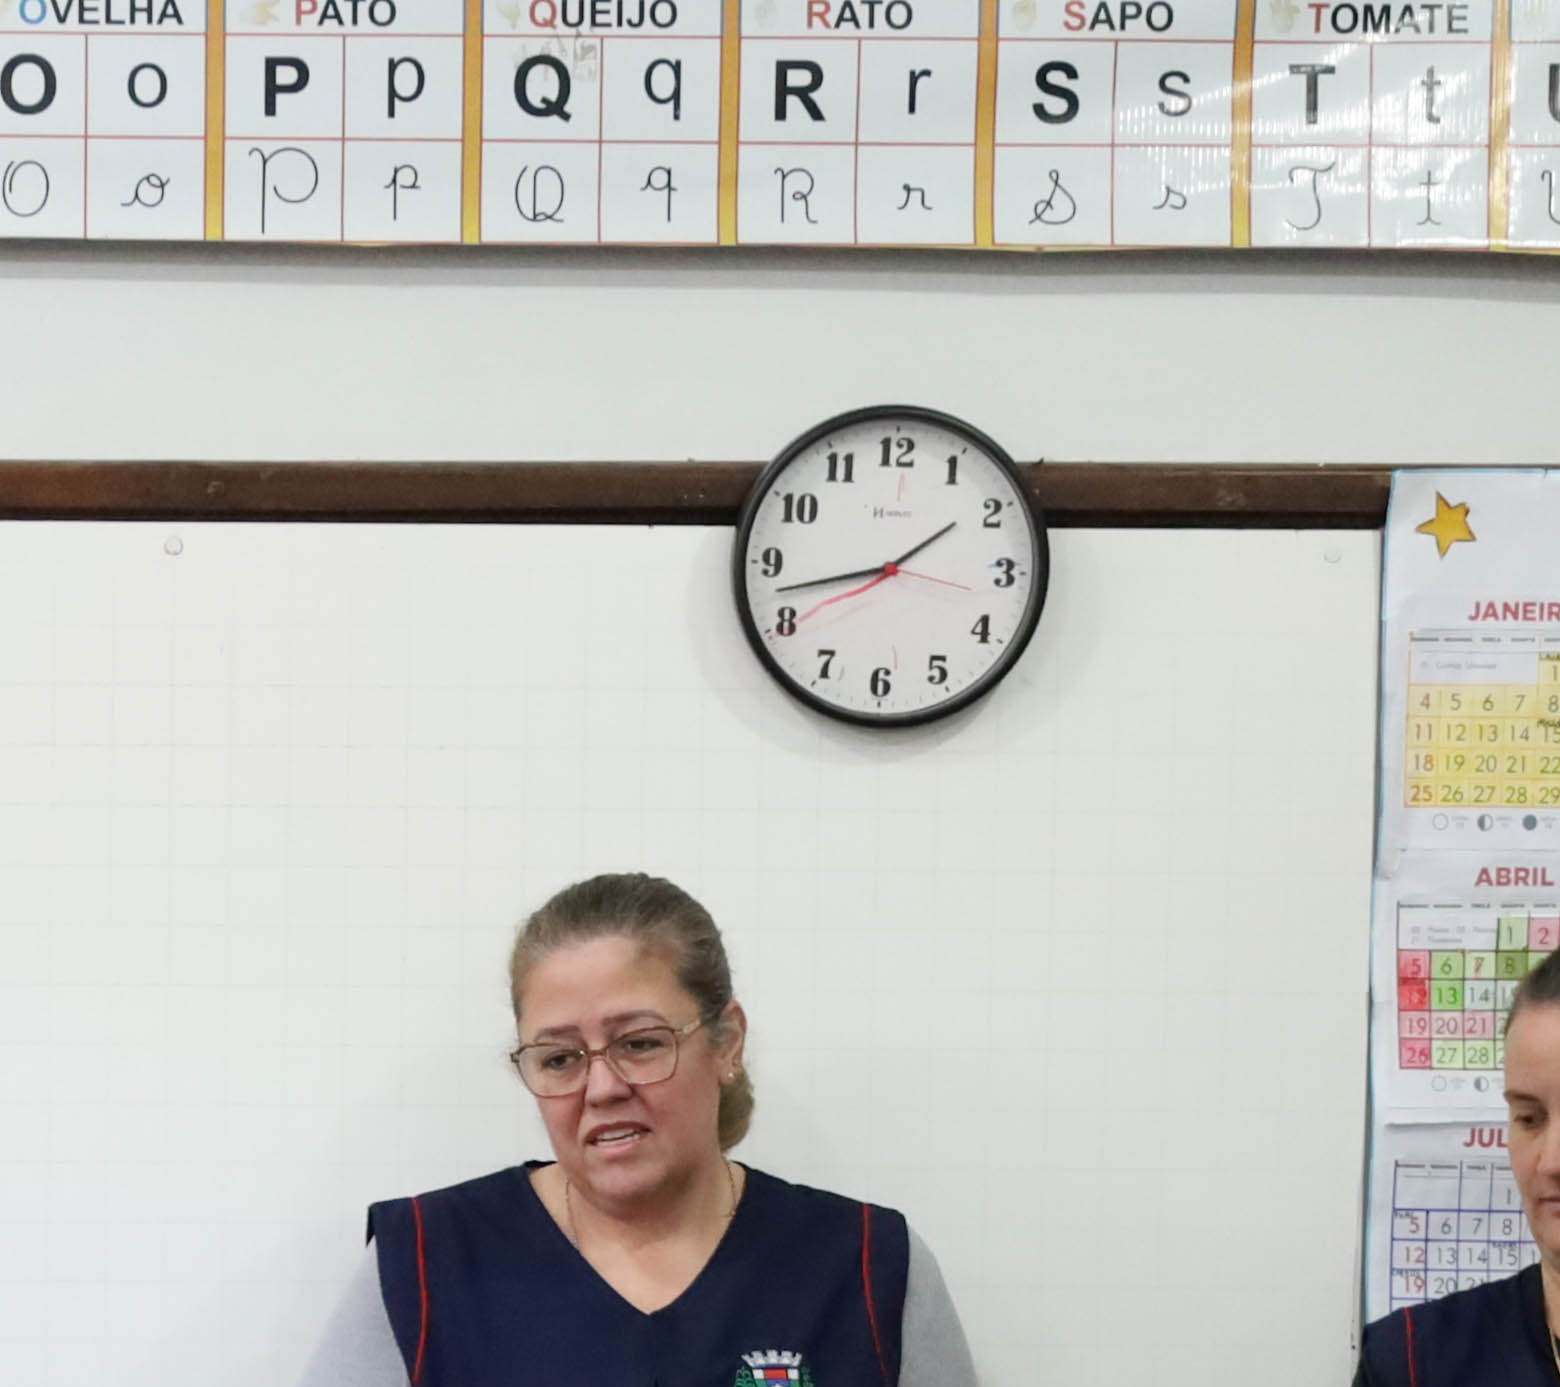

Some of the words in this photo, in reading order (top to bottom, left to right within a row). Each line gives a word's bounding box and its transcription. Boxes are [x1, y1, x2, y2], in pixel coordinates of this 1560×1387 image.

[20, 0, 183, 25] OVELHA
[296, 0, 396, 27] PATO
[530, 0, 677, 28] QUEIJO
[808, 0, 912, 30] RATO
[1064, 1, 1173, 32] SAPO
[1308, 3, 1467, 34] TOMATE
[0, 54, 56, 115] O
[128, 63, 167, 108] o
[265, 57, 309, 116] P
[388, 57, 425, 118] p
[514, 54, 571, 122] Q
[775, 60, 825, 121] R
[909, 69, 931, 114] r
[1033, 61, 1079, 124] S
[1289, 64, 1336, 124] T
[880, 436, 915, 467] 12
[827, 452, 853, 482] 11
[947, 455, 957, 485] 1
[782, 493, 818, 523] 10
[983, 498, 1002, 528] 2
[762, 548, 783, 577] 9
[994, 558, 1016, 587] 3
[776, 607, 796, 636] 8
[971, 614, 990, 643] 4
[818, 649, 835, 679] 7
[928, 655, 948, 684] 5
[870, 668, 891, 697] 6
[1475, 867, 1554, 886] ABRIL
